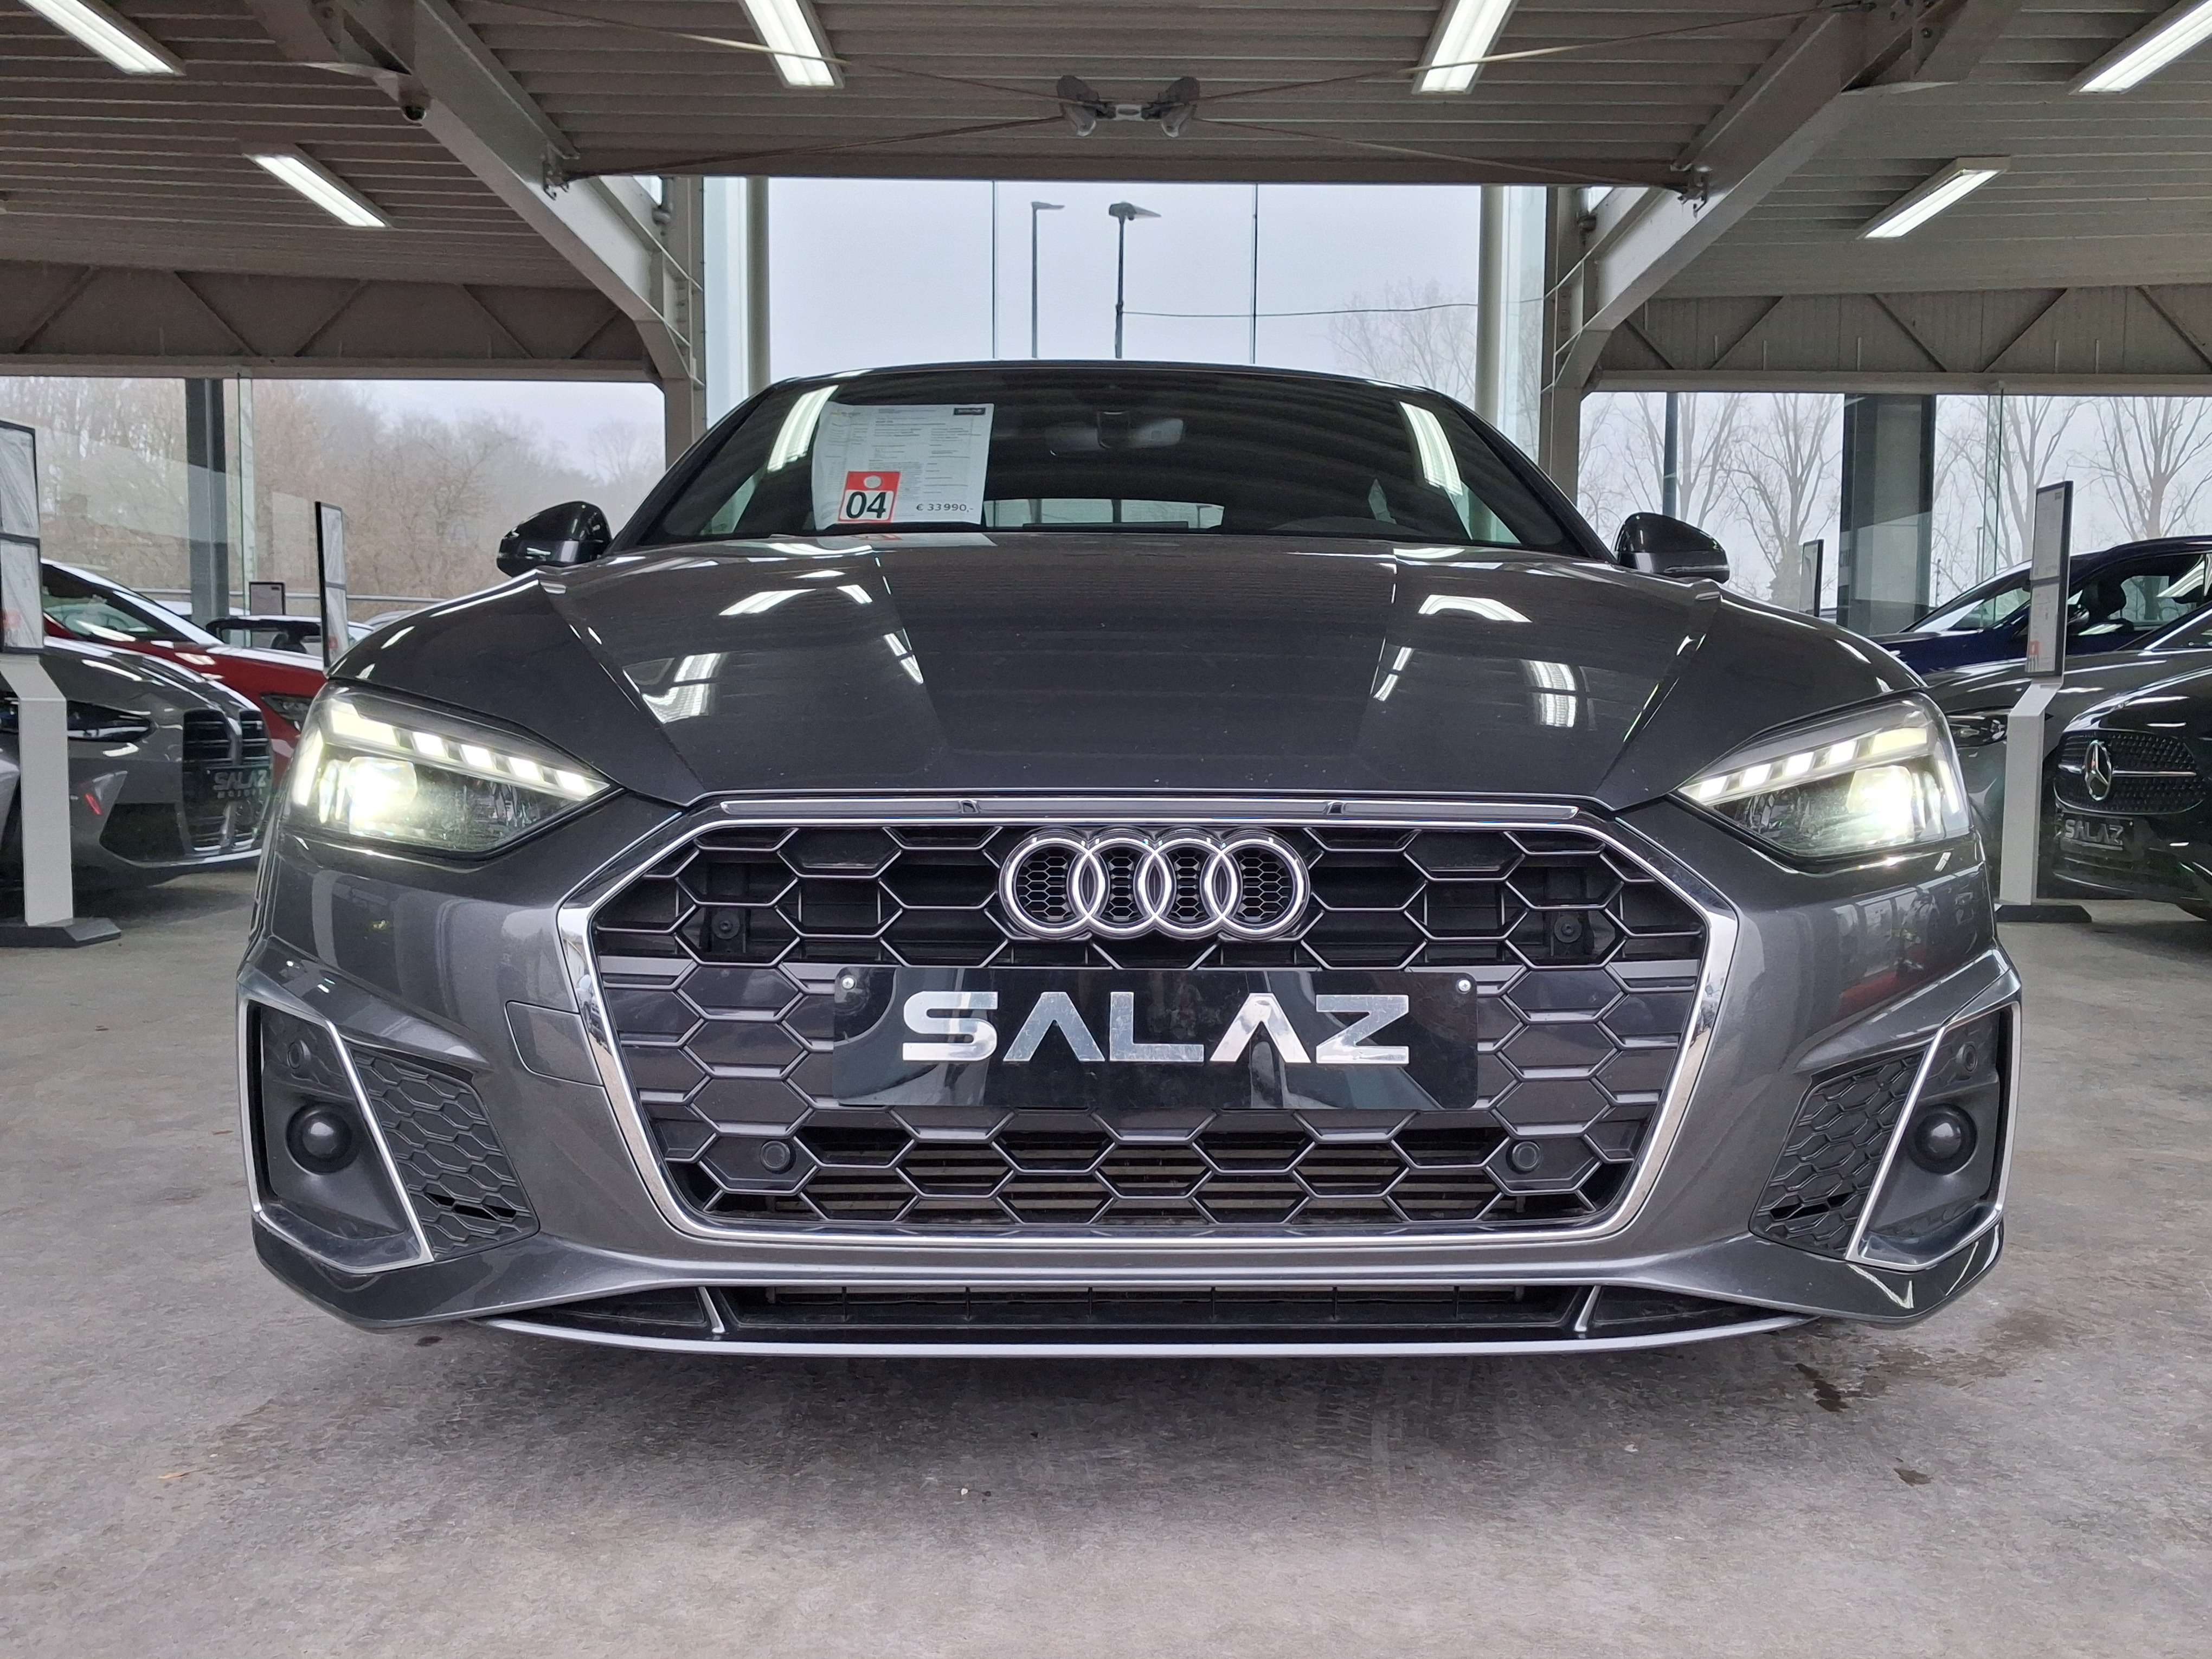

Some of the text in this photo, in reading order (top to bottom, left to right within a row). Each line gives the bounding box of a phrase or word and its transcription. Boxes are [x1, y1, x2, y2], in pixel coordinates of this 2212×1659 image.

[846, 491, 886, 519] 04
[916, 503, 923, 511] €
[2065, 819, 2124, 846] SALAZ
[902, 991, 1409, 1064] SALAZ
